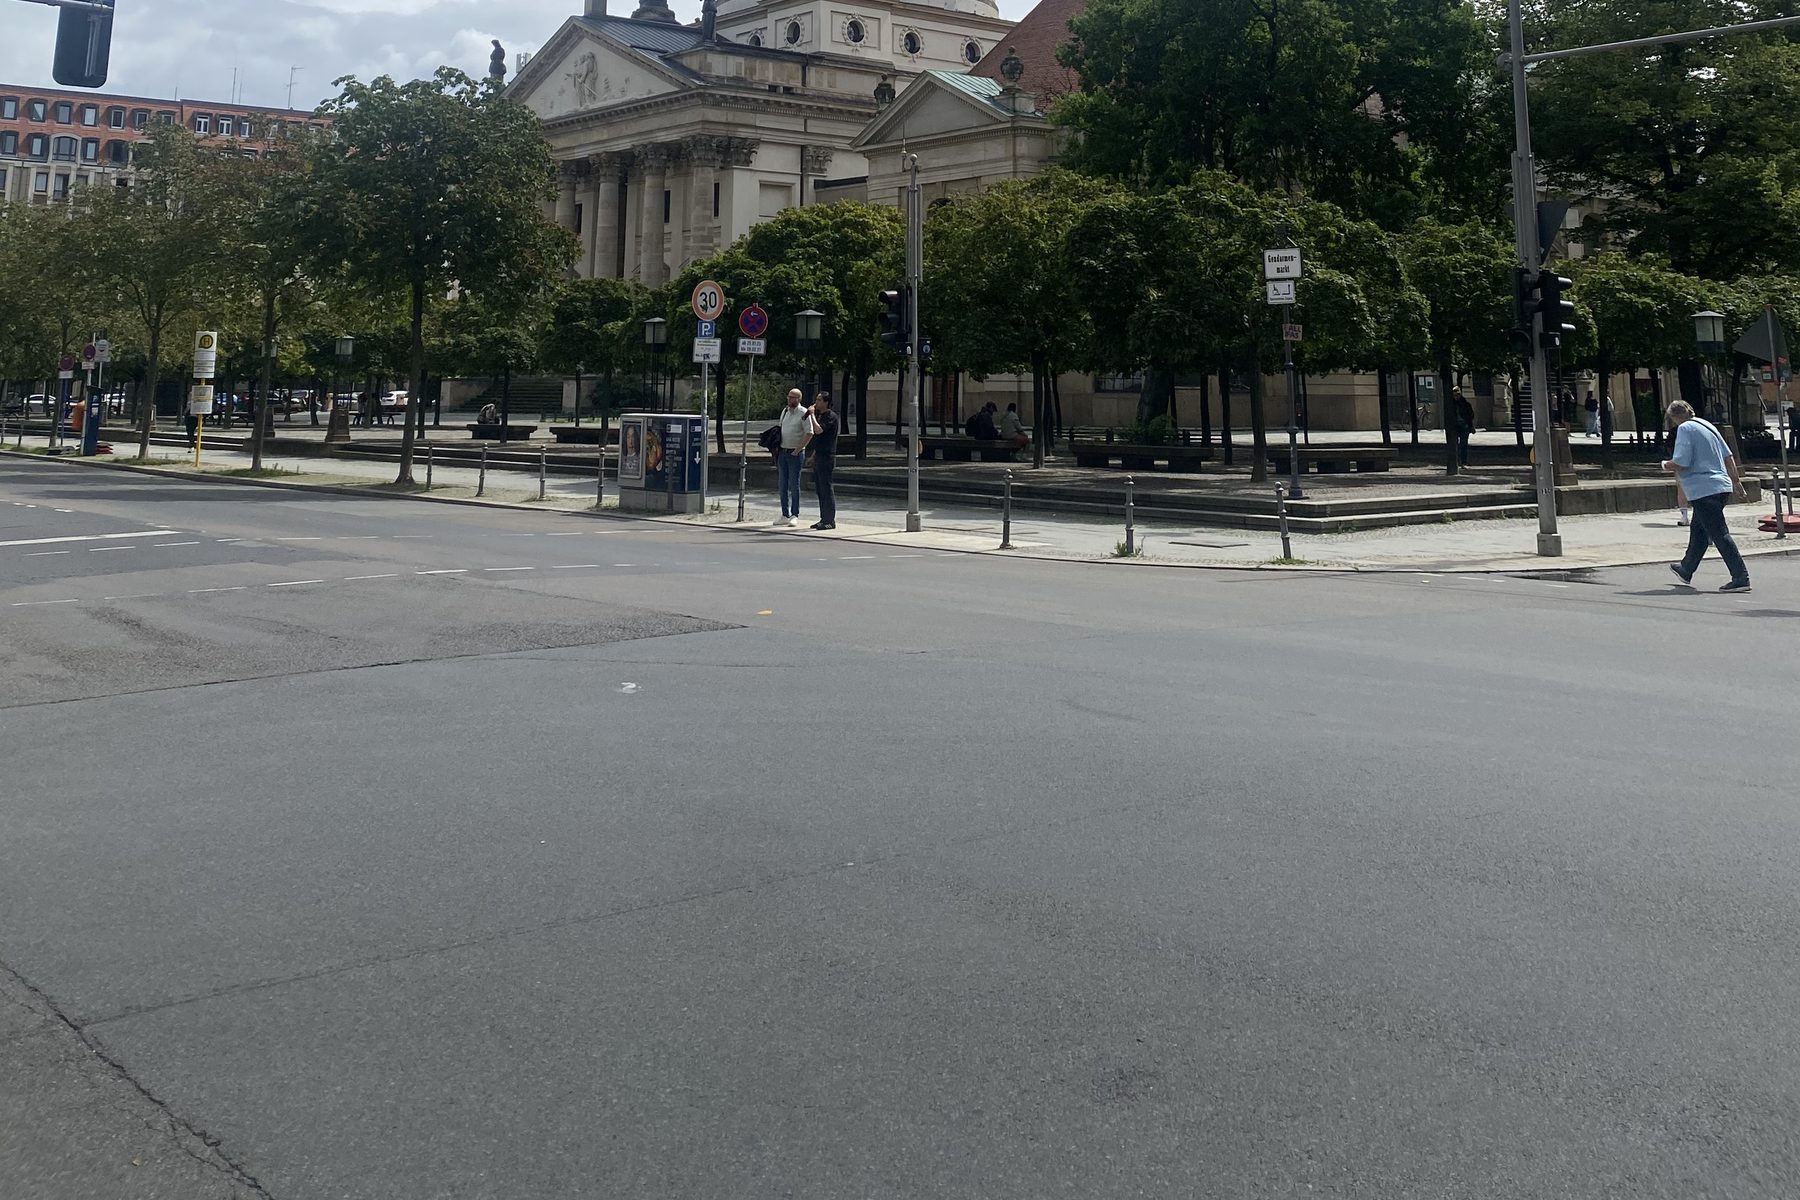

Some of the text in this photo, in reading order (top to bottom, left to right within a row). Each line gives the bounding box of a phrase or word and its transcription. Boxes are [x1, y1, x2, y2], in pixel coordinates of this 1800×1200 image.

[1267, 254, 1297, 263] Gendarmen-
[1276, 265, 1290, 274] markt
[699, 291, 717, 310] 30
[702, 323, 711, 336] P
